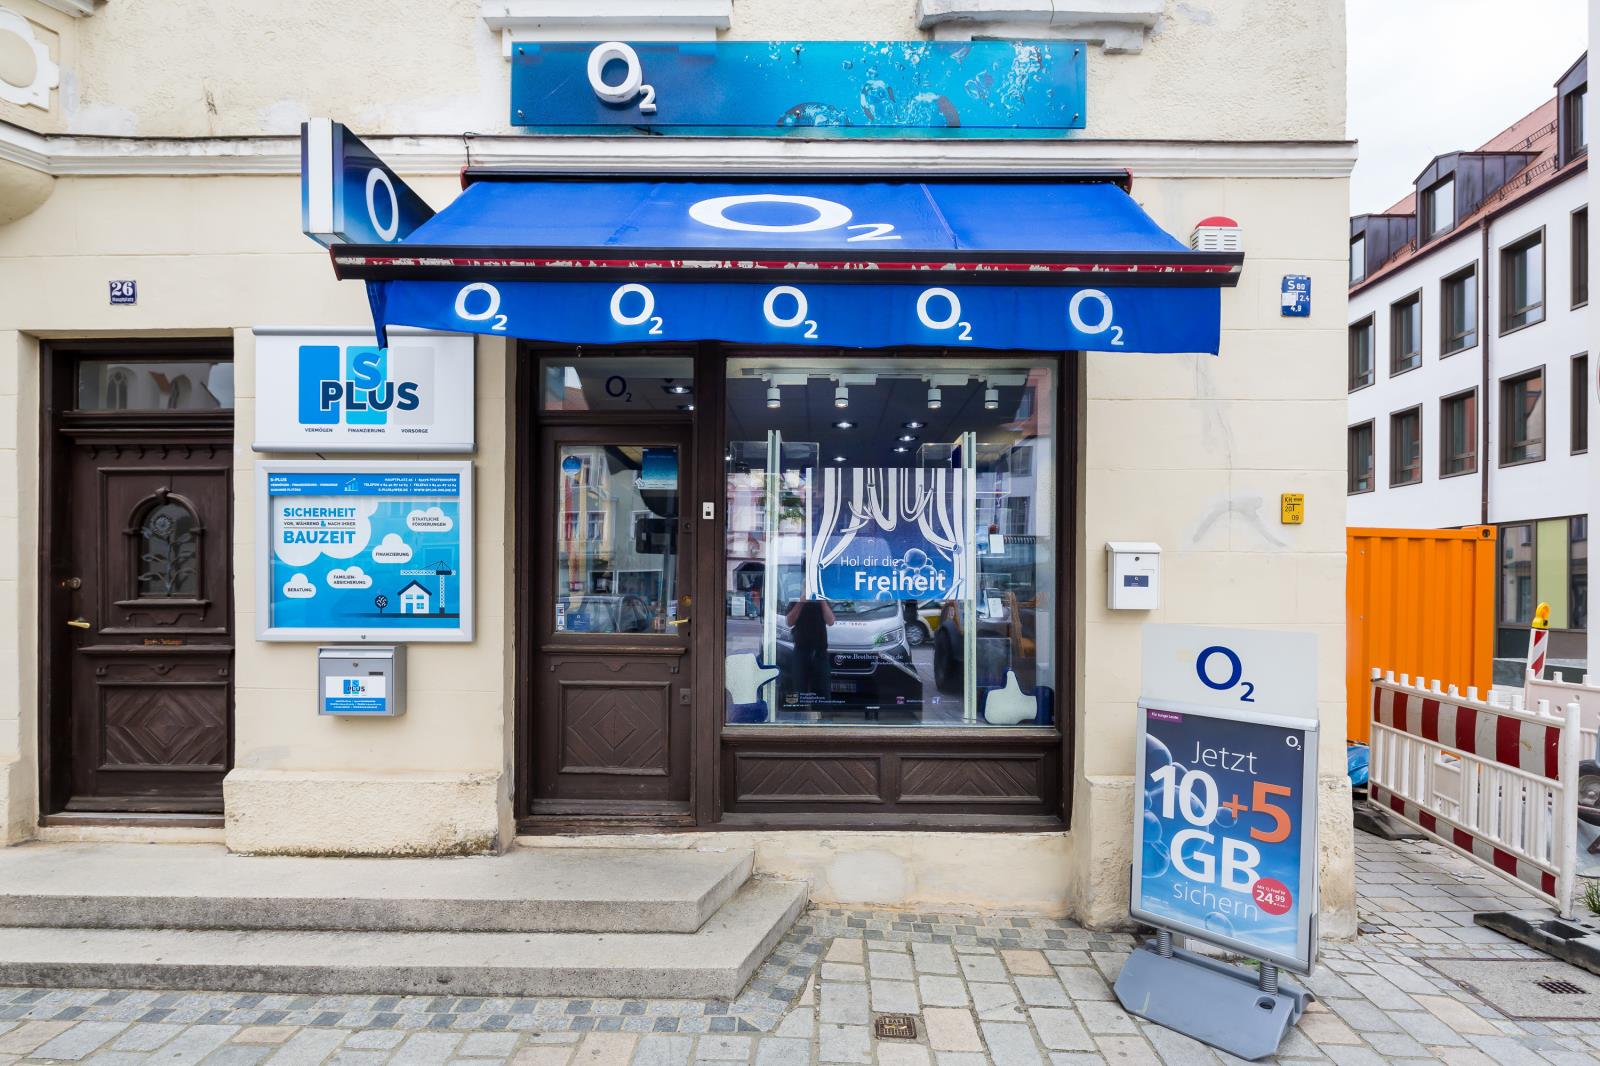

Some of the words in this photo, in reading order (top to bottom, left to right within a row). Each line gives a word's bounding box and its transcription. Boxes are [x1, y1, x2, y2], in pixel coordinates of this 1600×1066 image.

[587, 41, 657, 112] O2
[689, 194, 902, 243] O2
[111, 281, 134, 296] 26
[1288, 280, 1296, 290] S
[454, 282, 508, 330] O2
[610, 284, 663, 335] O2
[763, 286, 818, 339] O2
[917, 288, 973, 341] O2
[1069, 289, 1124, 346] O2
[353, 352, 381, 389] S
[320, 381, 420, 411] PLUS
[283, 507, 356, 518] SICHERHEIT
[283, 530, 356, 544] BAUZEIT
[840, 556, 861, 567] Hol
[863, 556, 879, 567] dir
[881, 556, 899, 567] die
[855, 570, 946, 592] Freiheit
[1196, 645, 1255, 703] O2
[1190, 741, 1258, 775] Jetzt
[1170, 828, 1261, 894] GB
[1172, 881, 1258, 922] sichern
